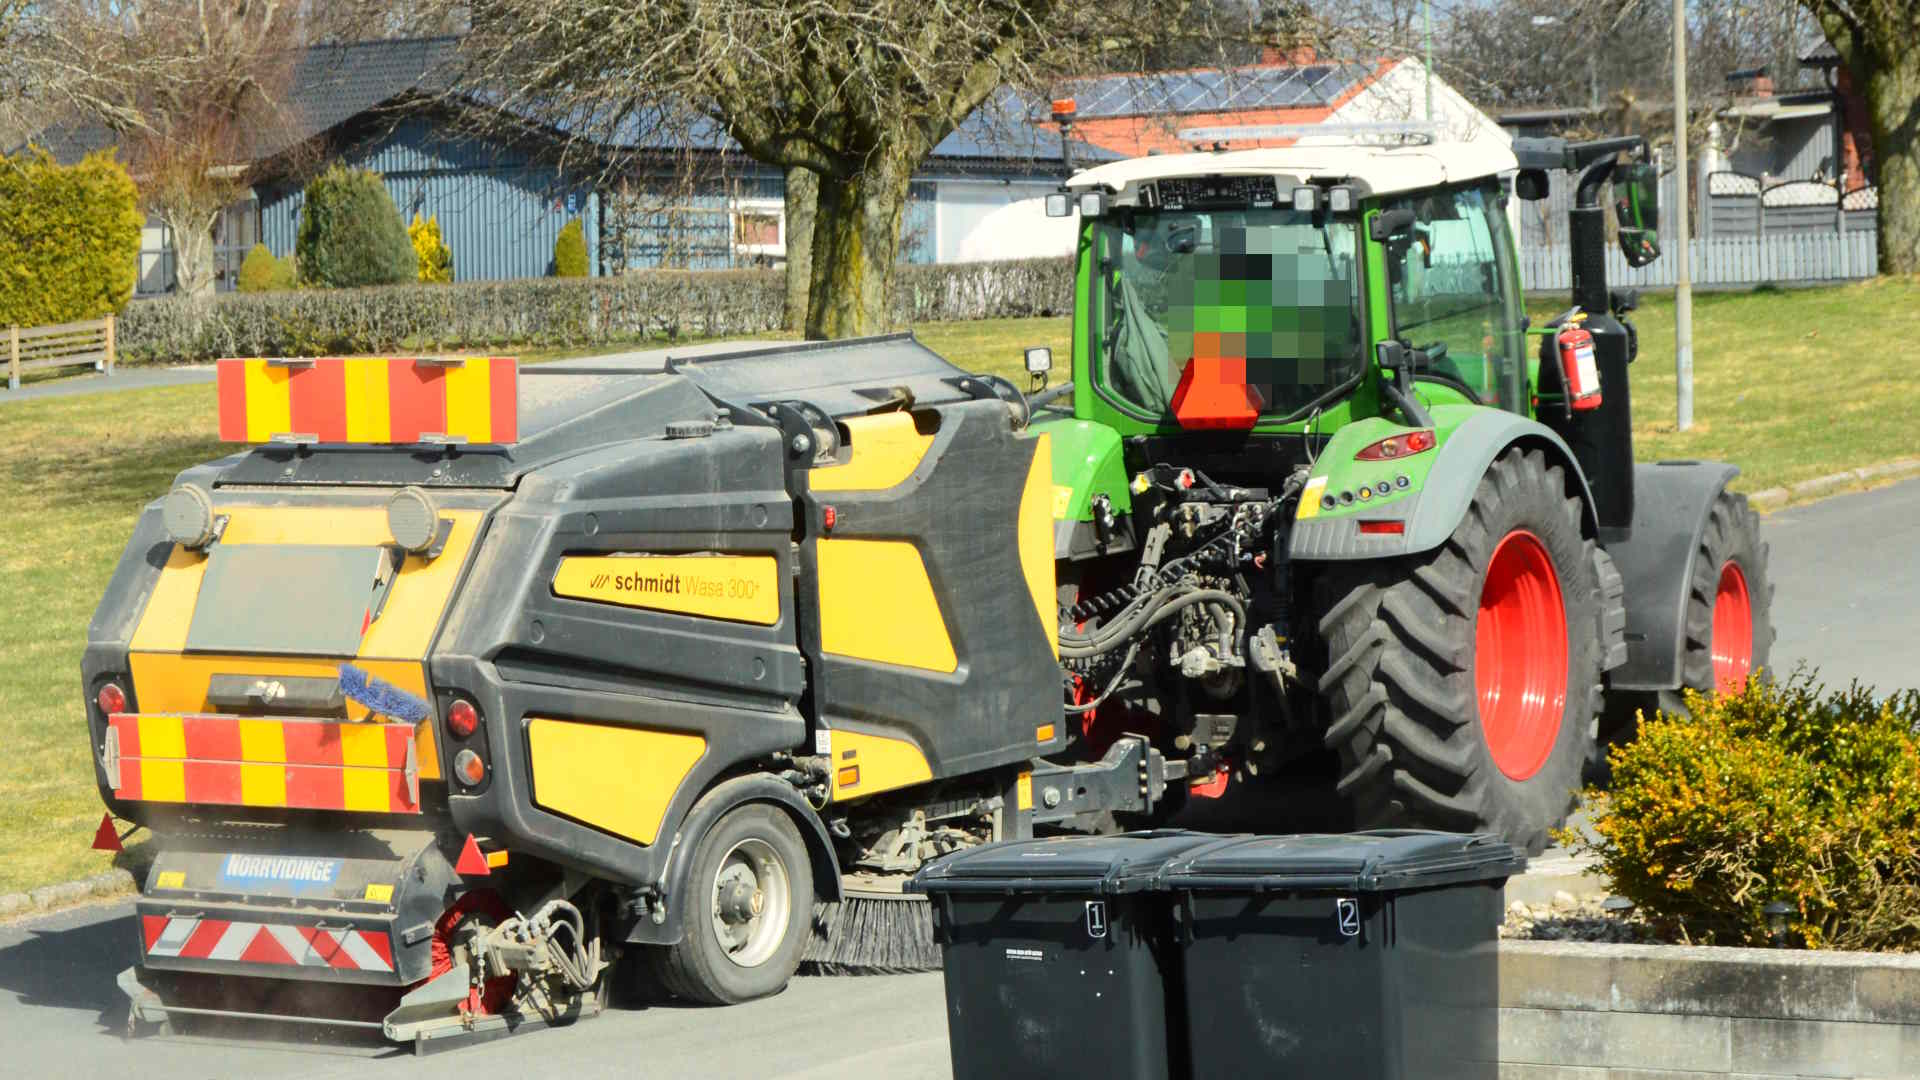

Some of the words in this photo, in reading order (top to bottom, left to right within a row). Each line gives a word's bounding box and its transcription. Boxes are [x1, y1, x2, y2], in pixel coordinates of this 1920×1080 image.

[615, 571, 680, 594] schmidt
[685, 575, 724, 598] Wasa
[226, 853, 336, 881] NORRVIDINGE
[1091, 905, 1103, 929] 1
[1342, 902, 1357, 926] 2
